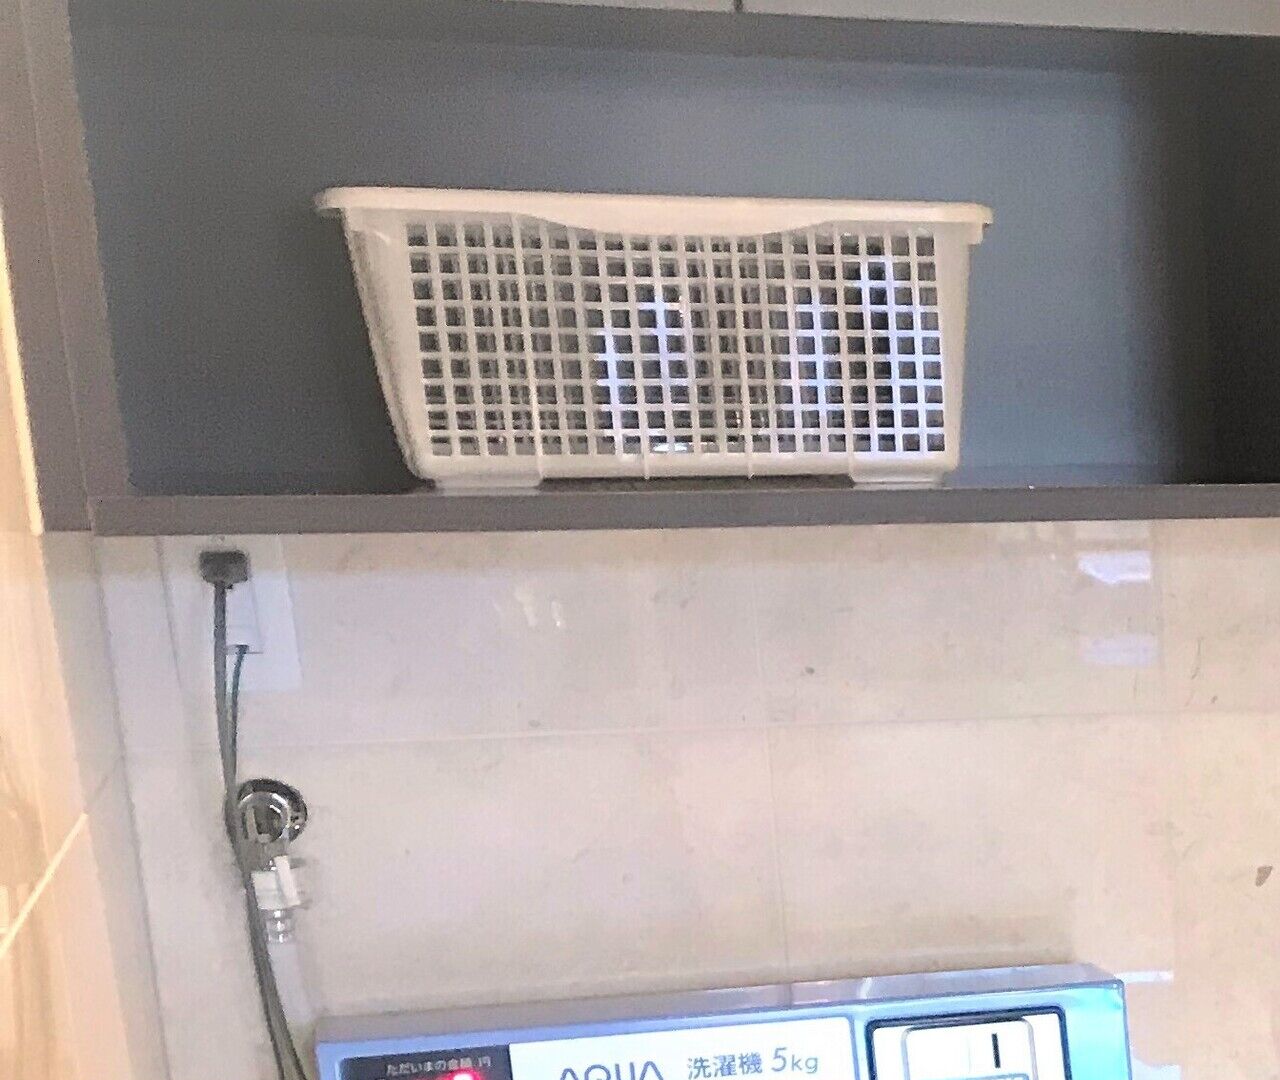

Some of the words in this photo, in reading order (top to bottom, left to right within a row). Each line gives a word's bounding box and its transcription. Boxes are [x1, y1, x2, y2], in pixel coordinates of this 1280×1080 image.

[687, 1052, 763, 1080] 洗濯機
[771, 1047, 819, 1074] 5kg
